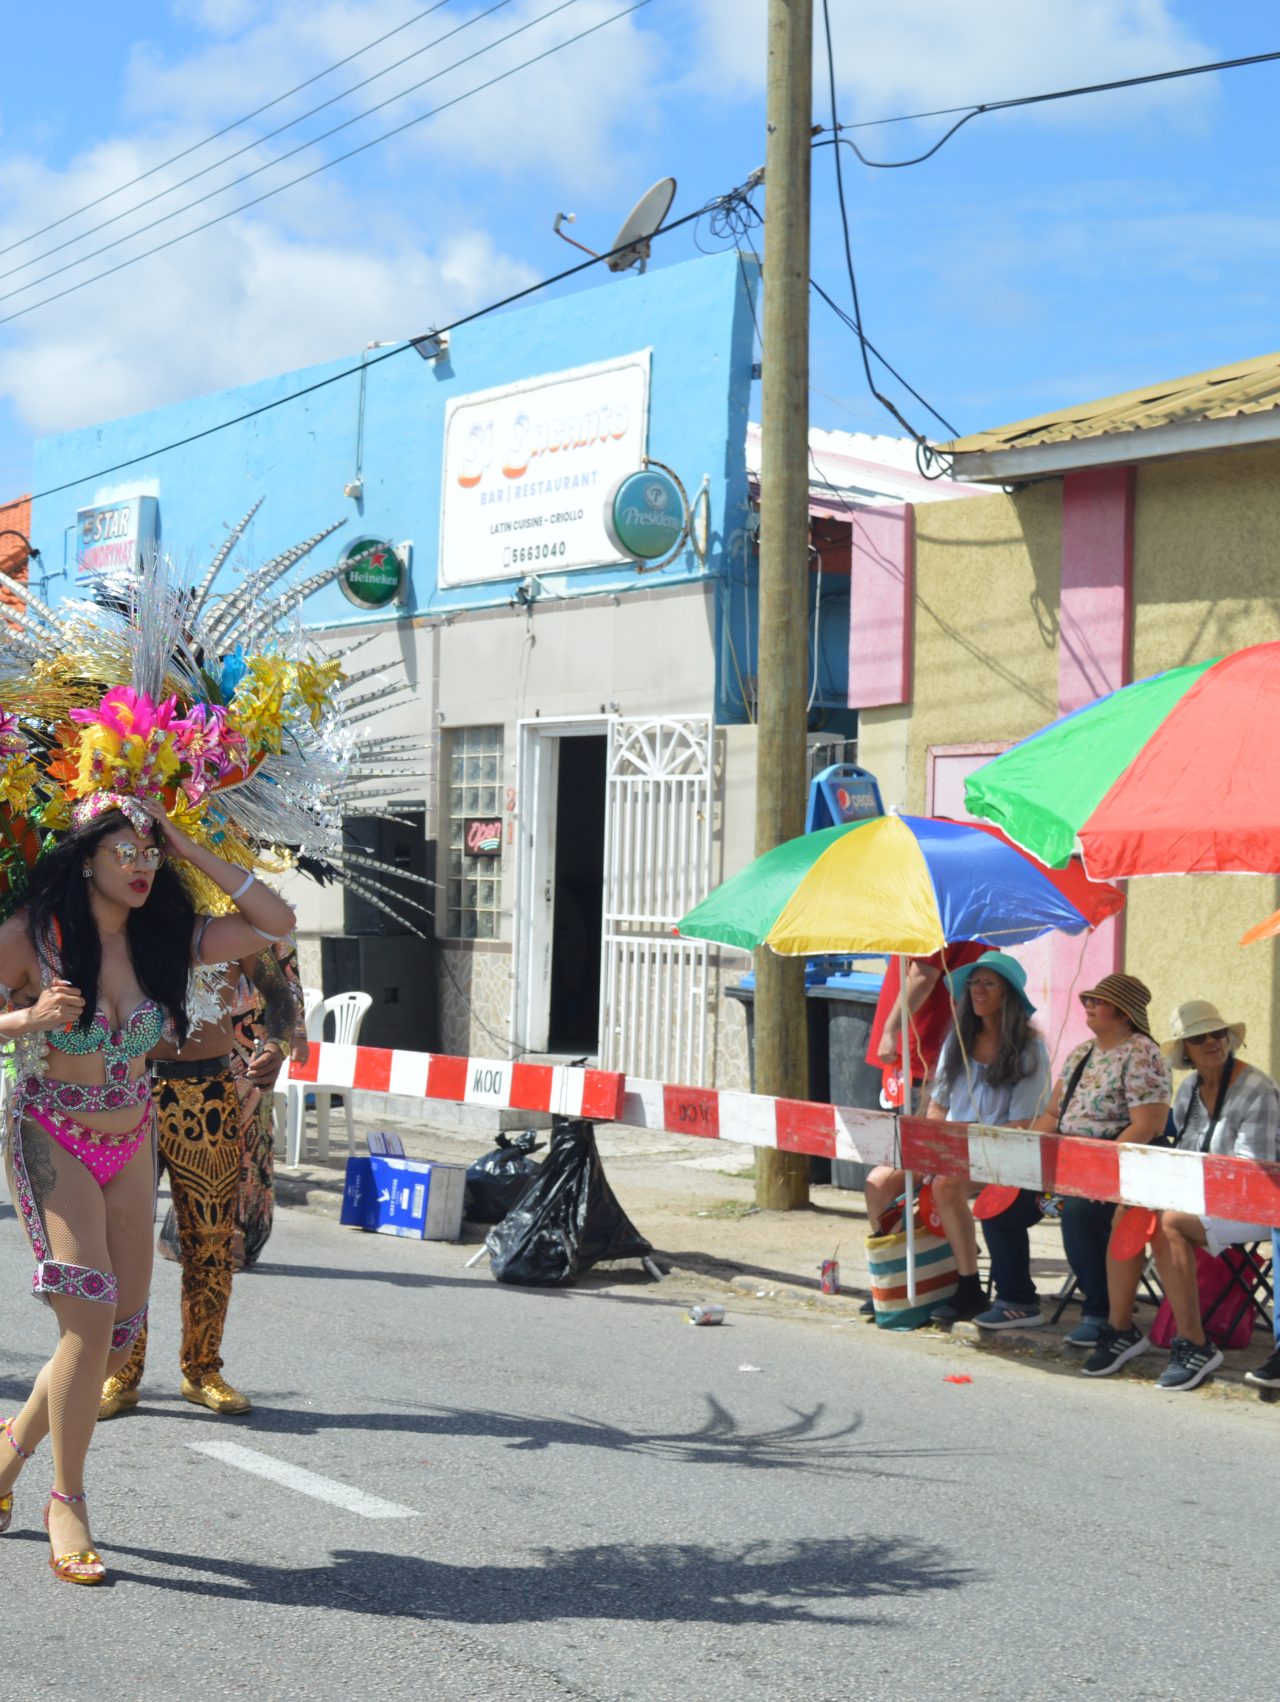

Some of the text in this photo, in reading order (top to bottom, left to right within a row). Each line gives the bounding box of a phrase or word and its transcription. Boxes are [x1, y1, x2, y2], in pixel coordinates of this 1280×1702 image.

[480, 470, 599, 506] BAR RESTAURANT
[489, 520, 513, 535] LATIN
[513, 515, 544, 531] CUISINE
[549, 509, 584, 525] CRIOLLO
[511, 540, 567, 564] 5663040
[349, 571, 398, 586] Heineken
[468, 822, 502, 853] Open
